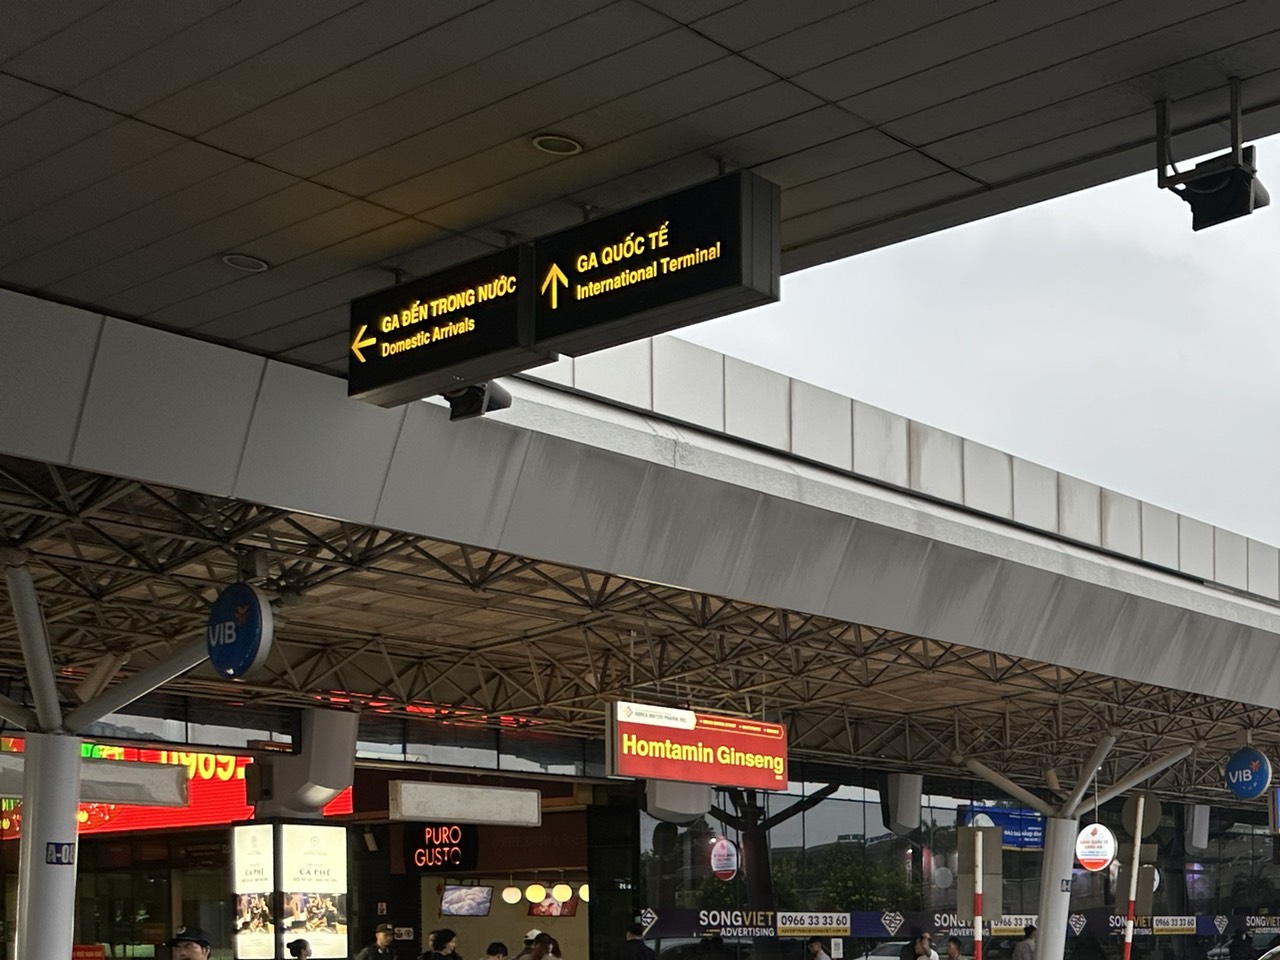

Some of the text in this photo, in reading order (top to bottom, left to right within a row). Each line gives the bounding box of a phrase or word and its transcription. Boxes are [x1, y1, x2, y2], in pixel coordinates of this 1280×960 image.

[577, 221, 669, 273] GA QUỐC TẾ
[576, 241, 721, 300] International Terminal
[382, 275, 516, 333] GA ĐẾN TRONG NƯỚC
[382, 317, 475, 357] Domestic Arrivals
[209, 621, 237, 647] VIB
[622, 733, 784, 775] Homtamin Ginseng
[1229, 769, 1252, 784] VIB
[425, 825, 462, 845] PURO
[414, 847, 462, 867] GUSTO
[700, 910, 847, 926] SONGVIET 0966 33 33 60
[1014, 917, 1022, 926] 33
[1109, 915, 1195, 927] SONVIET 0966 33 33 60
[1246, 915, 1280, 927] SONGVIET
[720, 927, 775, 937] ADVERTISING
